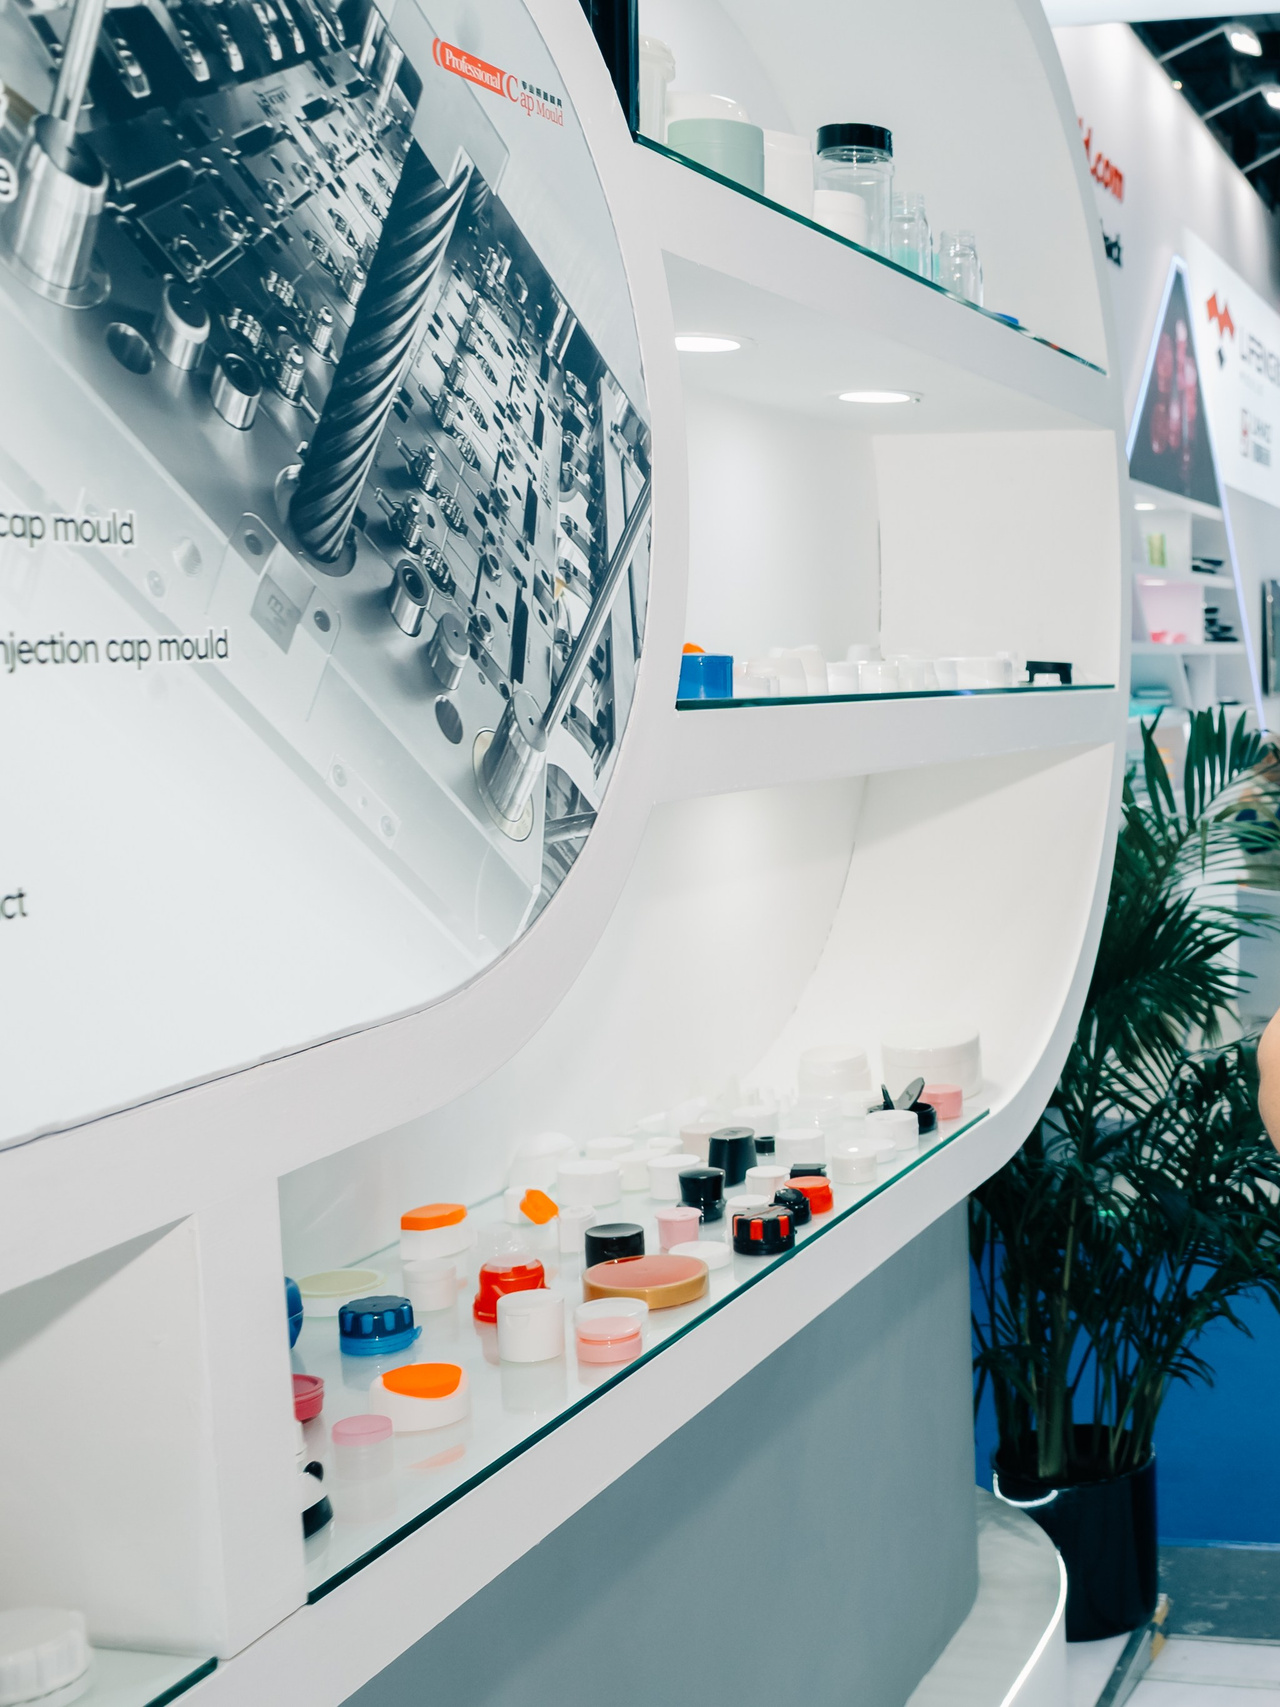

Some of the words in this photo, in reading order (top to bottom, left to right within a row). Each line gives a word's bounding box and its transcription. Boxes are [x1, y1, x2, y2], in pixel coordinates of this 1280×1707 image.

[444, 47, 502, 91] Professional
[506, 74, 535, 117] Cap
[536, 99, 564, 126] Mould
[54, 512, 135, 545] mould
[106, 638, 150, 671] cap
[158, 628, 229, 662] mould
